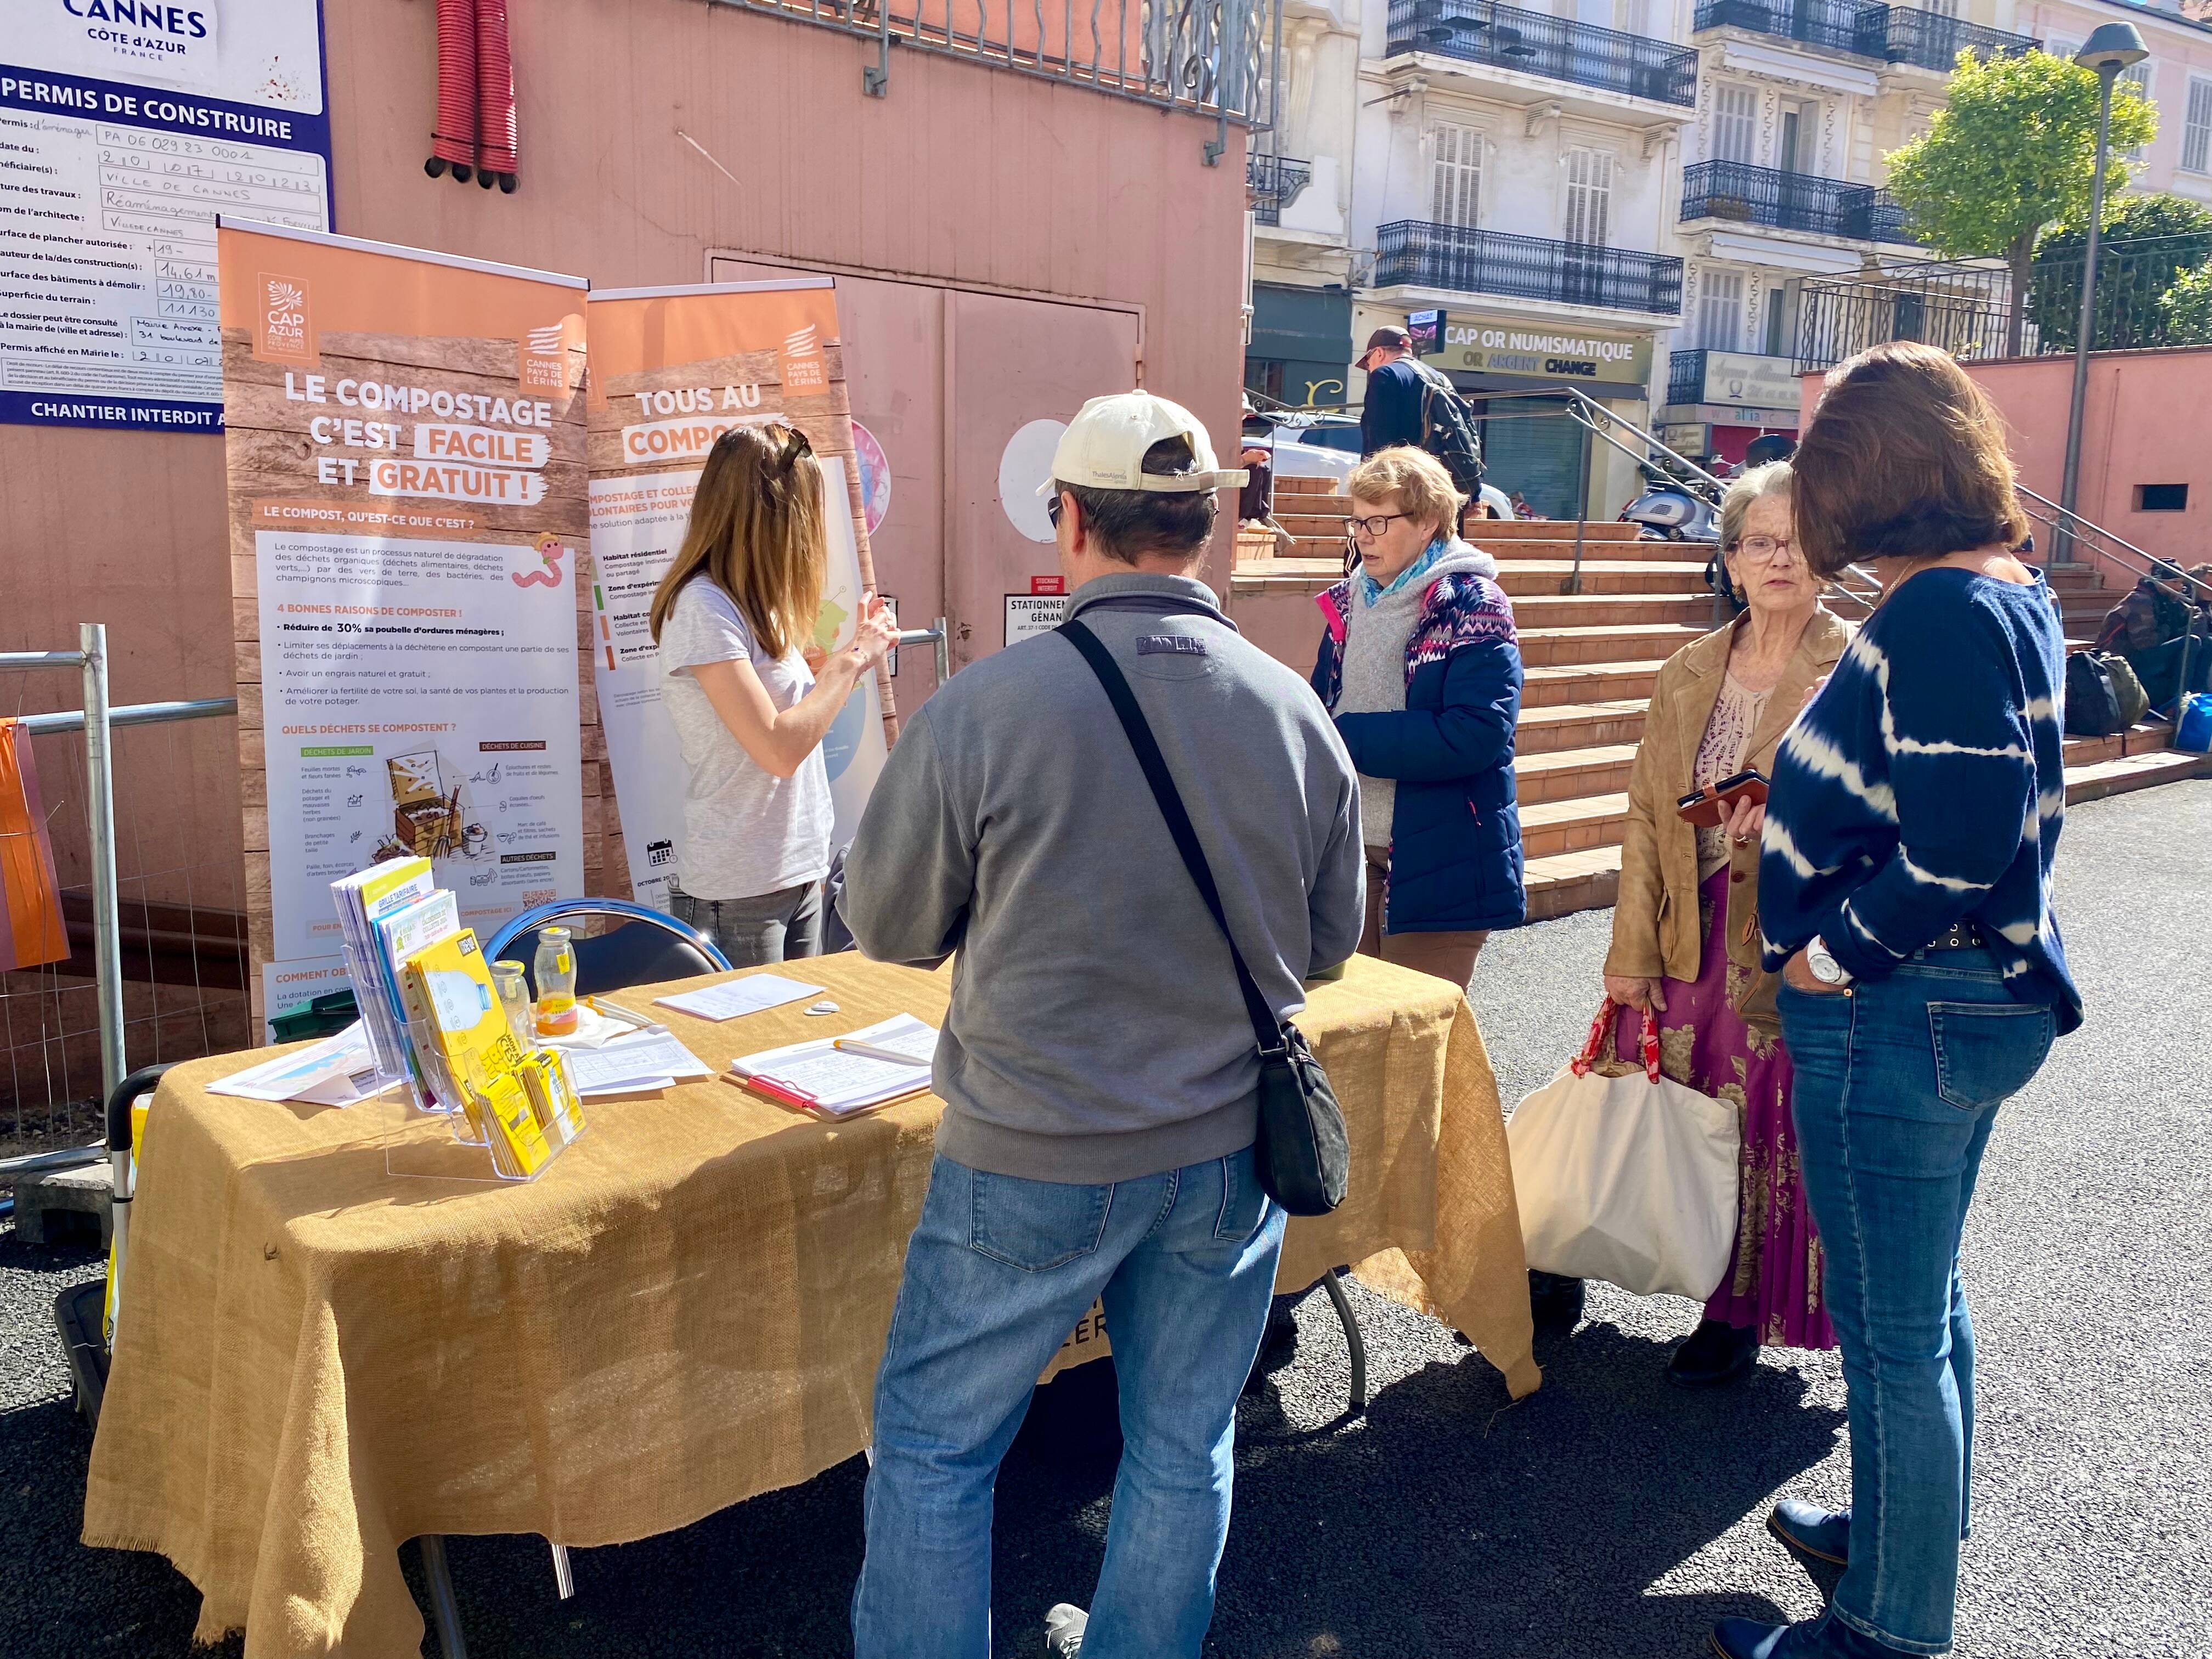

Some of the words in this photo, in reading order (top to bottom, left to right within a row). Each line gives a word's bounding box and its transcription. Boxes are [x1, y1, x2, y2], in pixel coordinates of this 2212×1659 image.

[88, 28, 128, 44] CÔTE
[133, 37, 185, 54] d'AZUR
[114, 47, 162, 61] FRANCE
[2, 77, 97, 109] PERMIS
[105, 94, 137, 115] DE
[144, 101, 291, 139] CONSTRUIRE
[105, 131, 121, 143] PA
[151, 137, 178, 152] 029
[184, 142, 203, 154] 23
[22, 185, 39, 194] des
[40, 188, 76, 198] travaux
[14, 207, 26, 215] de
[28, 208, 80, 221] l'architecte
[29, 232, 41, 240] de
[43, 233, 84, 245] plancher
[86, 239, 127, 250] autorisée
[32, 252, 43, 261] de
[45, 253, 72, 263] la/des
[74, 258, 138, 271] construction(s)
[32, 273, 49, 281] des
[50, 274, 97, 286] bâtiments
[106, 280, 141, 290] démolir
[46, 294, 58, 302] du
[59, 295, 91, 304] terrain
[10, 311, 42, 320] dossier
[64, 315, 81, 324] être
[82, 319, 118, 327] consulté
[268, 311, 304, 327] CAP
[5, 321, 14, 329] la
[15, 323, 43, 332] mairie
[44, 325, 56, 333] de
[57, 325, 78, 334] (ville
[89, 329, 123, 339] adresse)
[268, 325, 303, 338] AZUR
[0, 342, 33, 352] Permis
[34, 345, 65, 354] affiché
[81, 348, 109, 358] Mairie
[1445, 326, 1478, 347] CAP
[1481, 330, 1505, 350] OR
[1510, 332, 1633, 363] NUMISMATIQUE
[527, 359, 562, 370] CANNES
[787, 361, 820, 371] CANNES
[1463, 351, 1483, 367] OR
[1487, 353, 1541, 372] ARGENT
[1545, 359, 1596, 377] CHANGE
[527, 368, 549, 377] PAYS
[551, 370, 562, 379] DE
[788, 370, 808, 378] PAYS
[285, 373, 327, 403] LE
[336, 379, 551, 427] COMPOSTAGE
[635, 387, 714, 416] TOUS
[722, 384, 761, 409] AU
[31, 403, 126, 420] CHANTIER
[131, 408, 212, 425] INTERDIT
[310, 416, 402, 450] C'EST
[428, 430, 533, 462] FACILE
[318, 458, 359, 486] ET
[377, 462, 510, 498] GRATUIT
[647, 489, 658, 499] ET
[651, 500, 678, 510] POUR
[264, 506, 279, 517] LE
[283, 507, 345, 522] COMPOST,
[347, 511, 406, 526] QU'EST-CE
[409, 516, 432, 527] QUE
[436, 517, 466, 529] C'EST
[600, 520, 632, 529] solution
[635, 515, 668, 525] adaptée
[631, 549, 667, 558] résidentiel
[605, 561, 644, 569] Compostage
[276, 573, 337, 584] champignons
[616, 569, 640, 578] partagé
[610, 590, 647, 600] Compostage
[276, 603, 285, 612] 4
[287, 603, 332, 614] BONNES
[334, 605, 380, 616] RAISONS
[381, 606, 394, 616] DE
[396, 607, 456, 618] COMPOSTER
[613, 612, 640, 621] Habitat
[283, 623, 319, 631] Réduire
[337, 623, 362, 633] 30%
[375, 626, 411, 634] poubelle
[455, 628, 500, 636] ménagères
[616, 628, 649, 636] Volontaires
[283, 651, 319, 659] déchets
[335, 652, 358, 661] jardin
[281, 725, 318, 735] QUELS
[320, 722, 366, 734] DÉCHETS
[368, 724, 381, 733] SE
[382, 723, 449, 733] COMPOSTENT
[304, 748, 335, 756] DÉCHETS
[637, 877, 662, 887] OCTOBRE
[379, 893, 393, 908] GRILLE
[393, 884, 418, 900] TARIFAIRE
[461, 907, 503, 917] COMPOSTAGE
[276, 969, 329, 984] COMMENT
[289, 989, 322, 998] dotation
